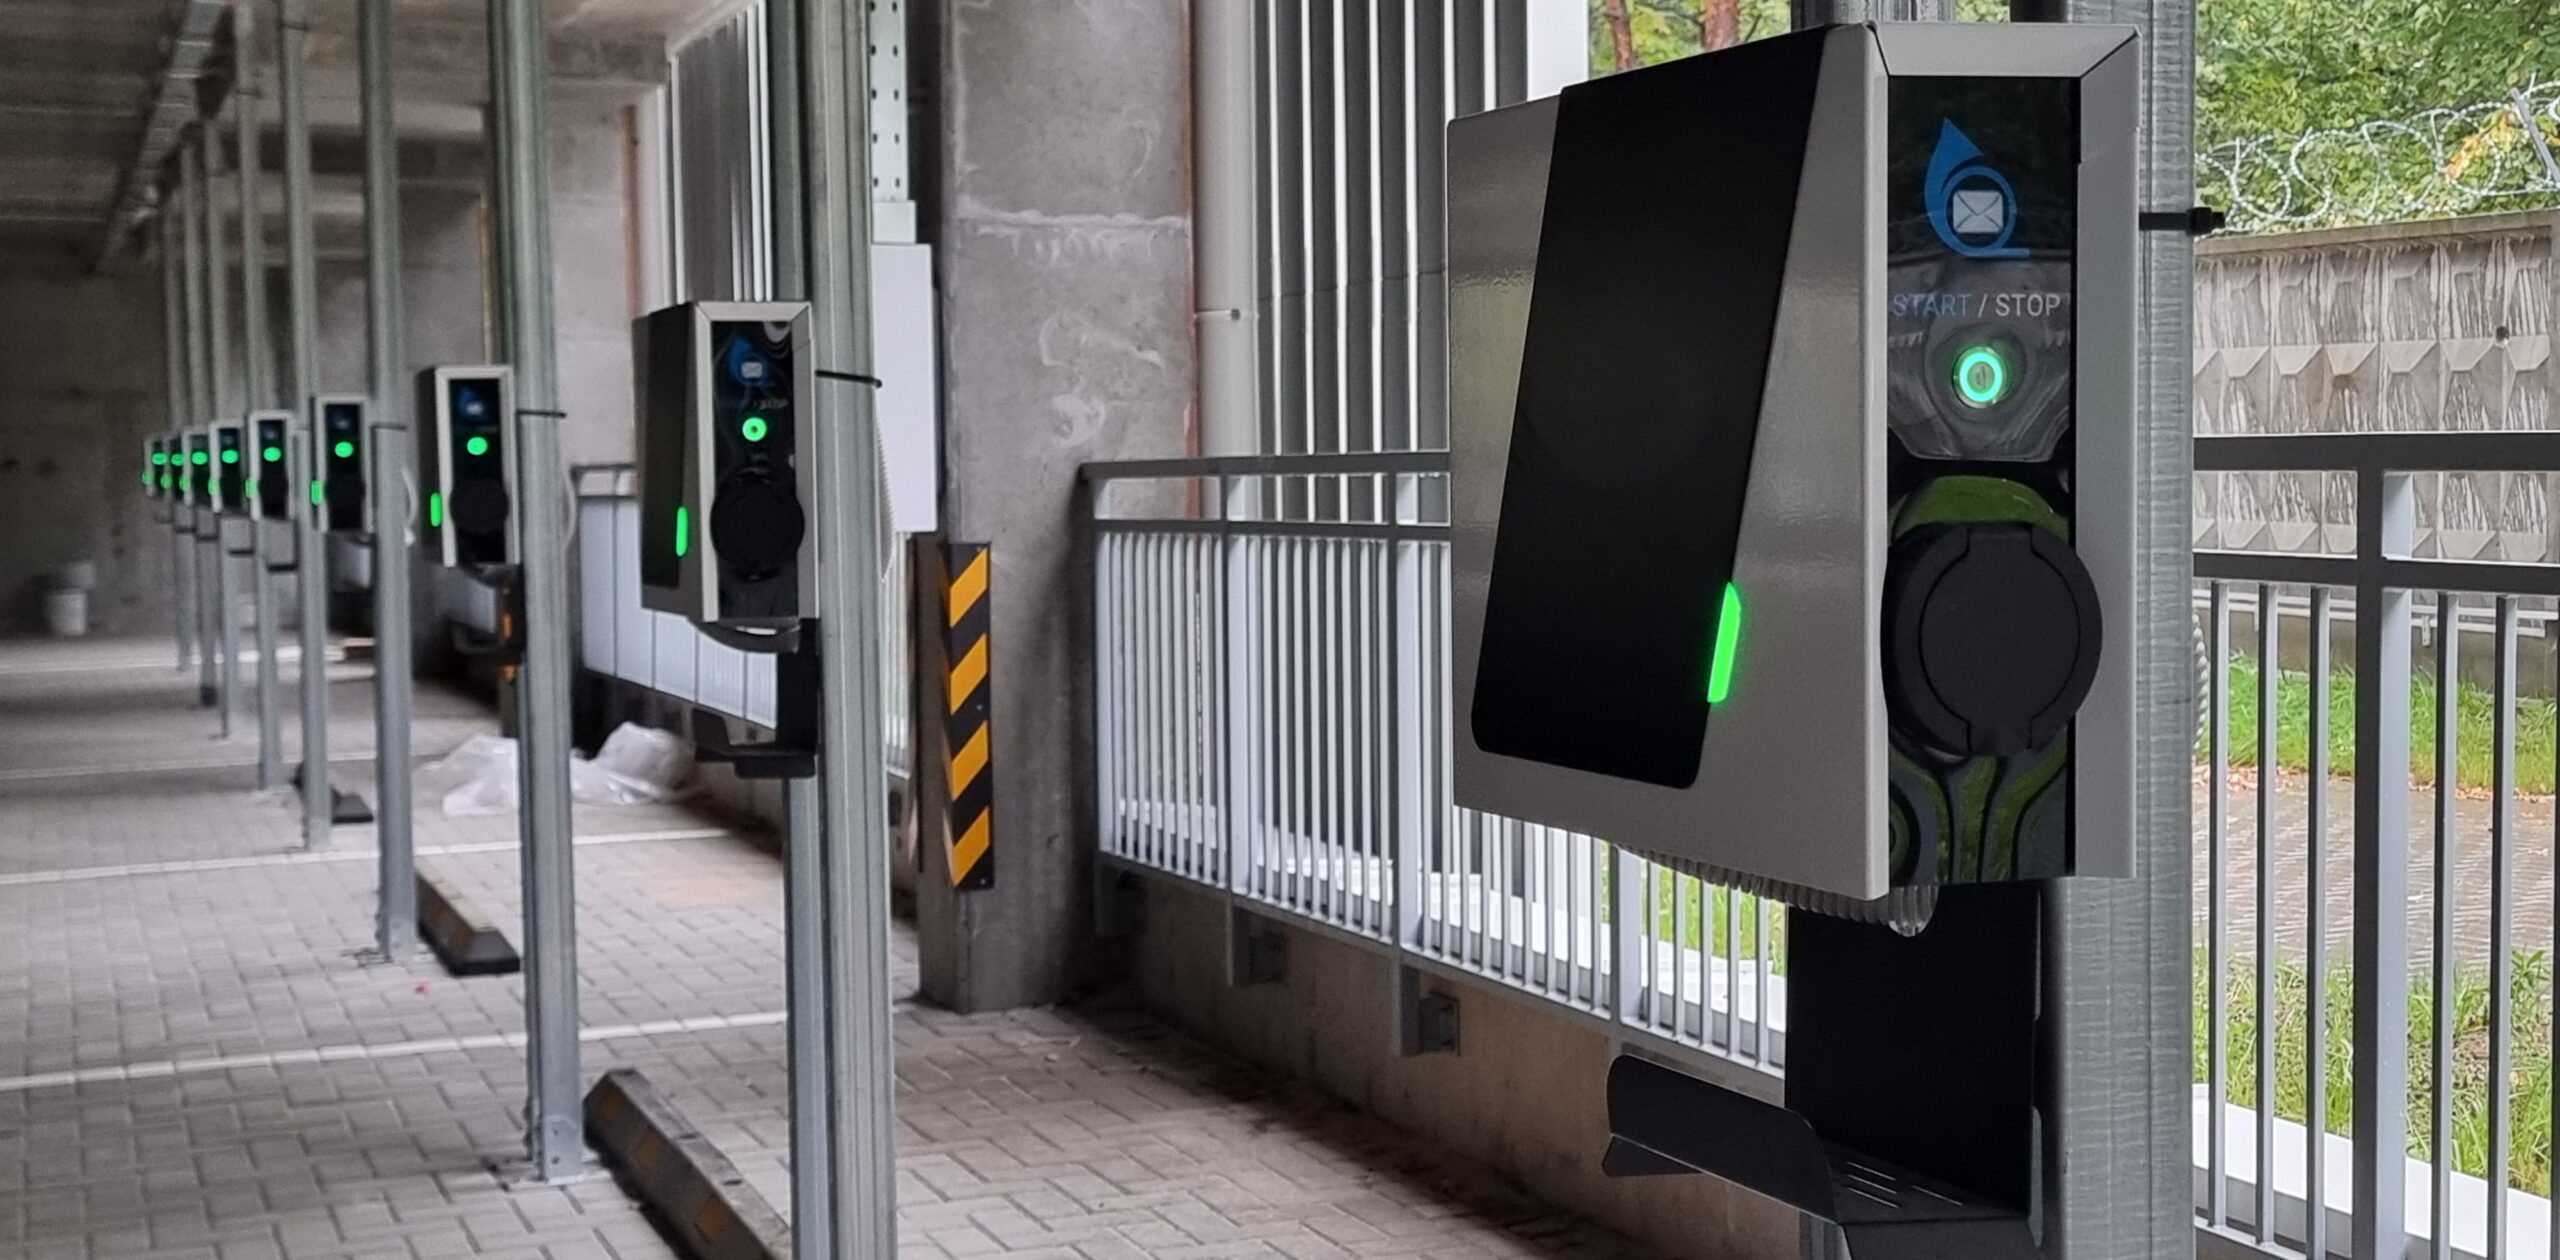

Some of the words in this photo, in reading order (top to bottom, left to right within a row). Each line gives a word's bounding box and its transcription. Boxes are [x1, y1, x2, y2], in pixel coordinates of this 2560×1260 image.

[1893, 293, 1968, 317] START
[1977, 294, 1986, 317] /
[1994, 293, 2061, 317] STOP
